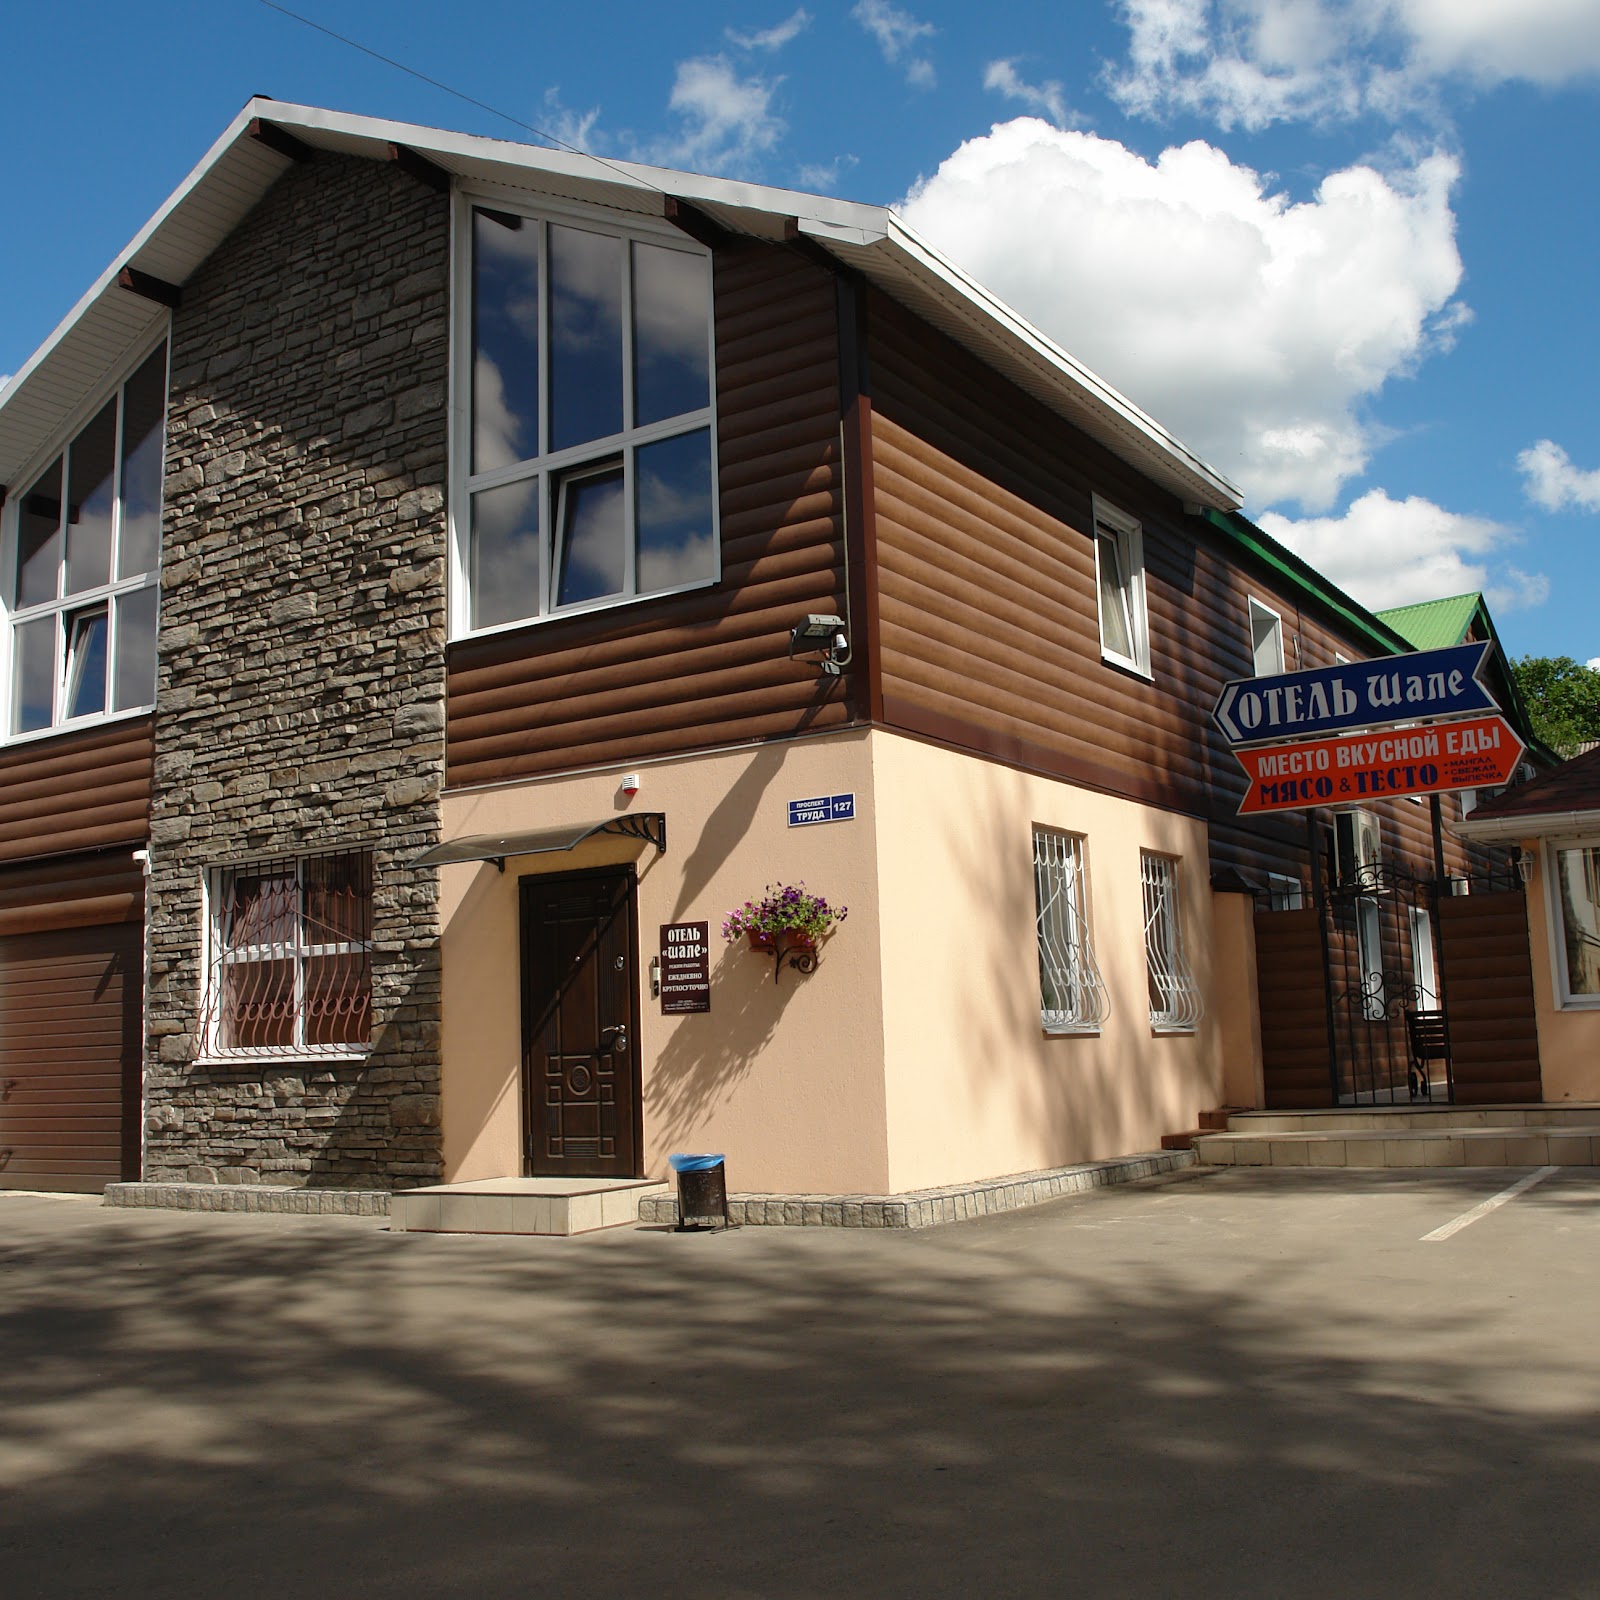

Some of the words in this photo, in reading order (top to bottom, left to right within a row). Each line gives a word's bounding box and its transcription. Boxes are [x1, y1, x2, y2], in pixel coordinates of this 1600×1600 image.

[1238, 678, 1358, 729] ОТЕЛЬ
[1367, 669, 1466, 708] Шале
[1257, 748, 1329, 778] МЕСТО
[1337, 730, 1440, 767] ВКУСНОЙ
[1446, 726, 1501, 756] ЕДЫ
[1450, 756, 1492, 767] МАНГАЛ
[1450, 764, 1497, 775] СВЕЖАЯ
[1451, 771, 1503, 783] ВЫПЕЧКА
[1260, 776, 1333, 805] МЯСО
[1339, 778, 1352, 792] &
[1354, 763, 1438, 794] ТЕСТО
[796, 800, 825, 808] ПРОСПЕКТ
[833, 802, 851, 811] 127
[796, 810, 825, 821] ТРУДА
[668, 928, 700, 942] ОТЕЛЬ
[668, 973, 702, 981] ЕЖЕДНЕВНО
[662, 984, 708, 992] КРУГЛОСУТОЧНО
